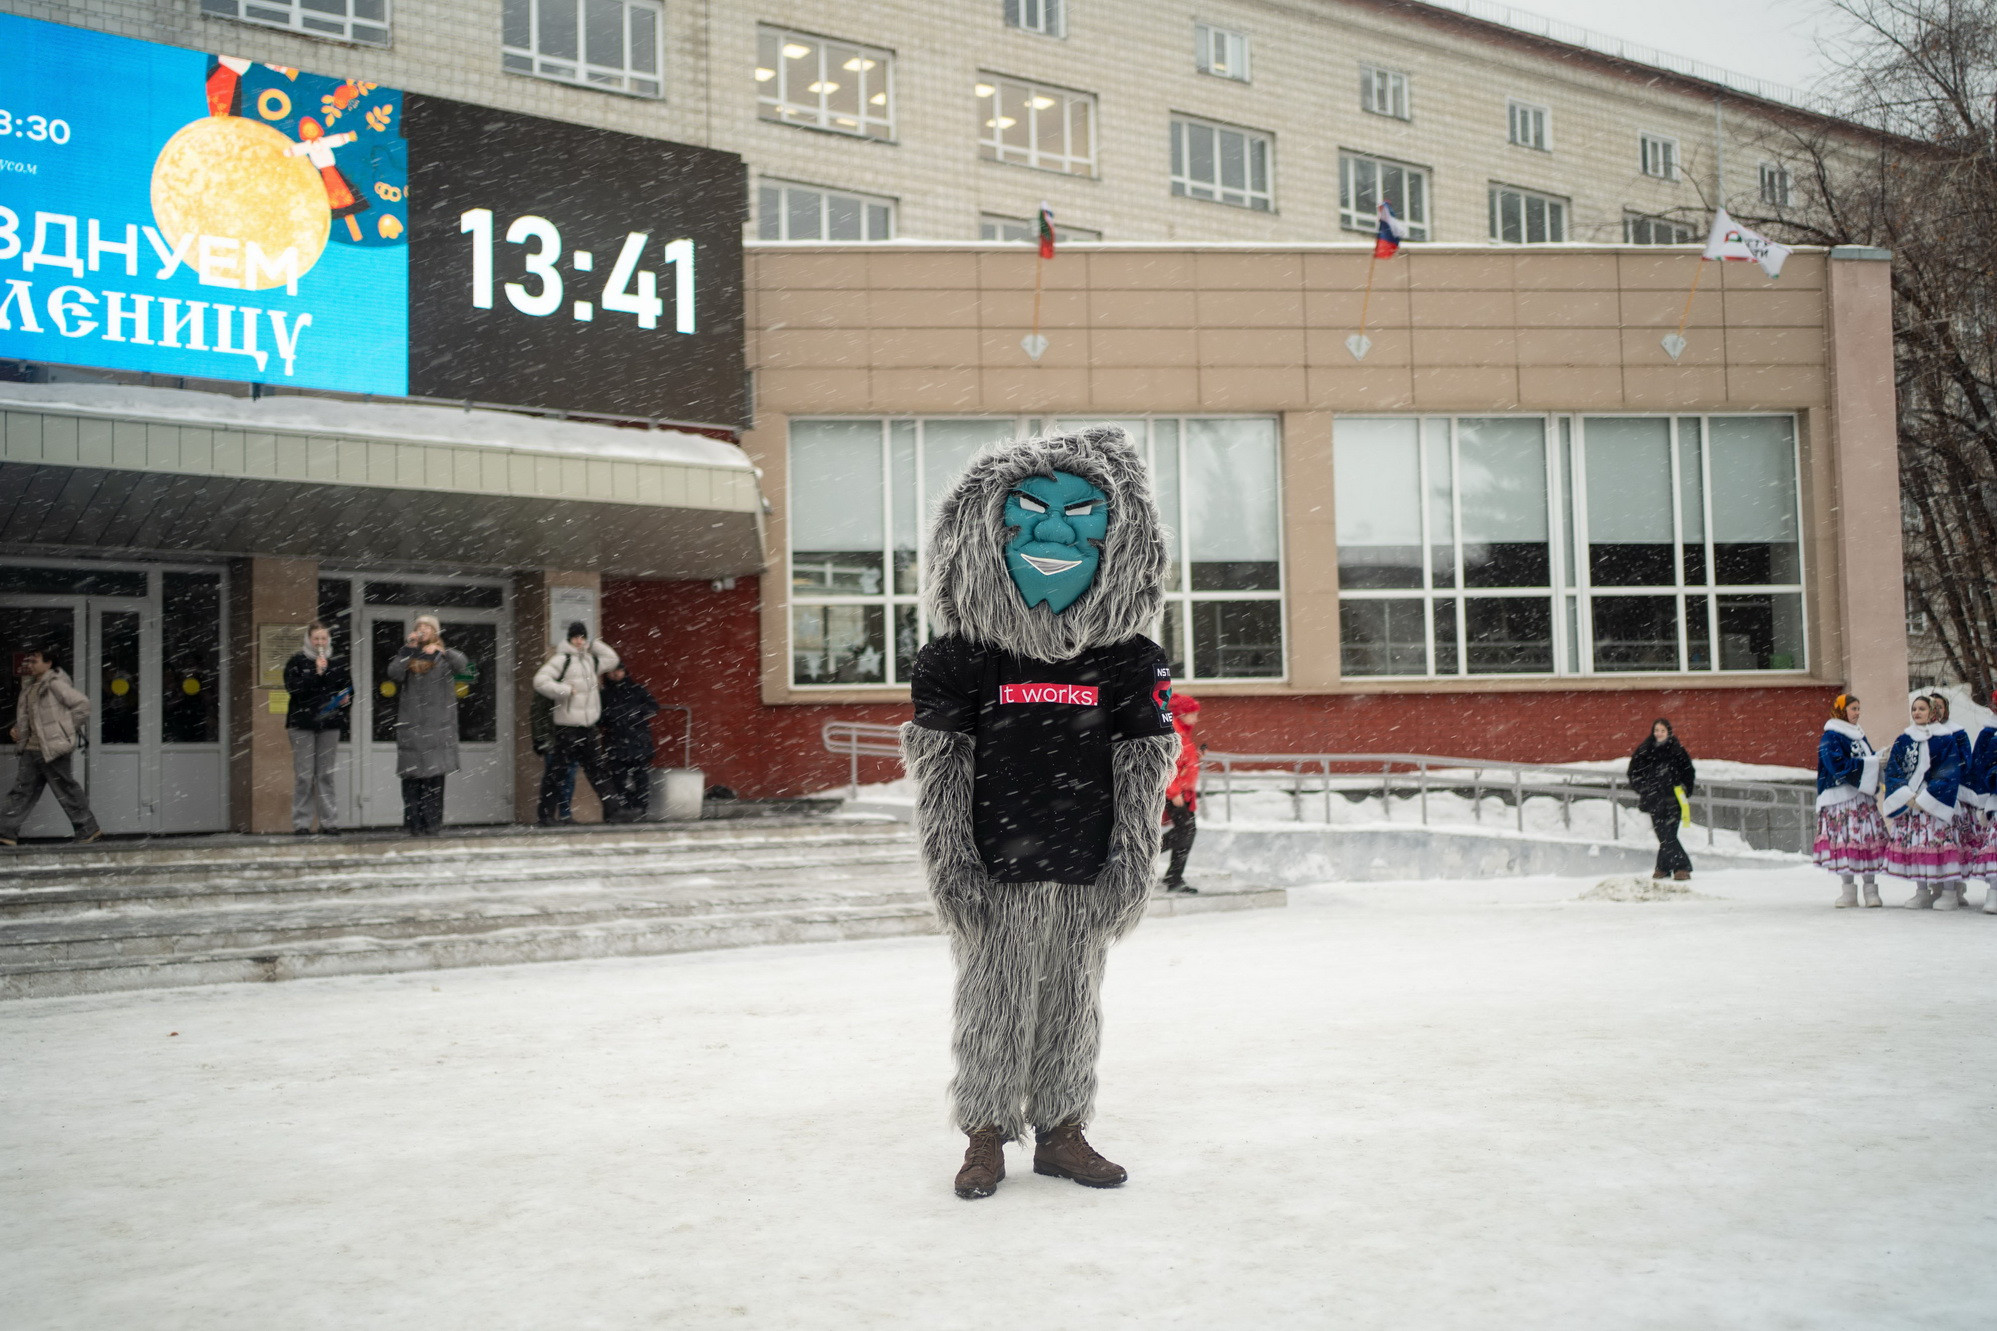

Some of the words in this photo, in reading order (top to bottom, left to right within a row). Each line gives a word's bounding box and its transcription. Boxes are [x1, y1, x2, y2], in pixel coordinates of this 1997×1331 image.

[460, 207, 696, 335] 13:41
[999, 685, 1015, 705] It
[1022, 684, 1098, 706] works.
